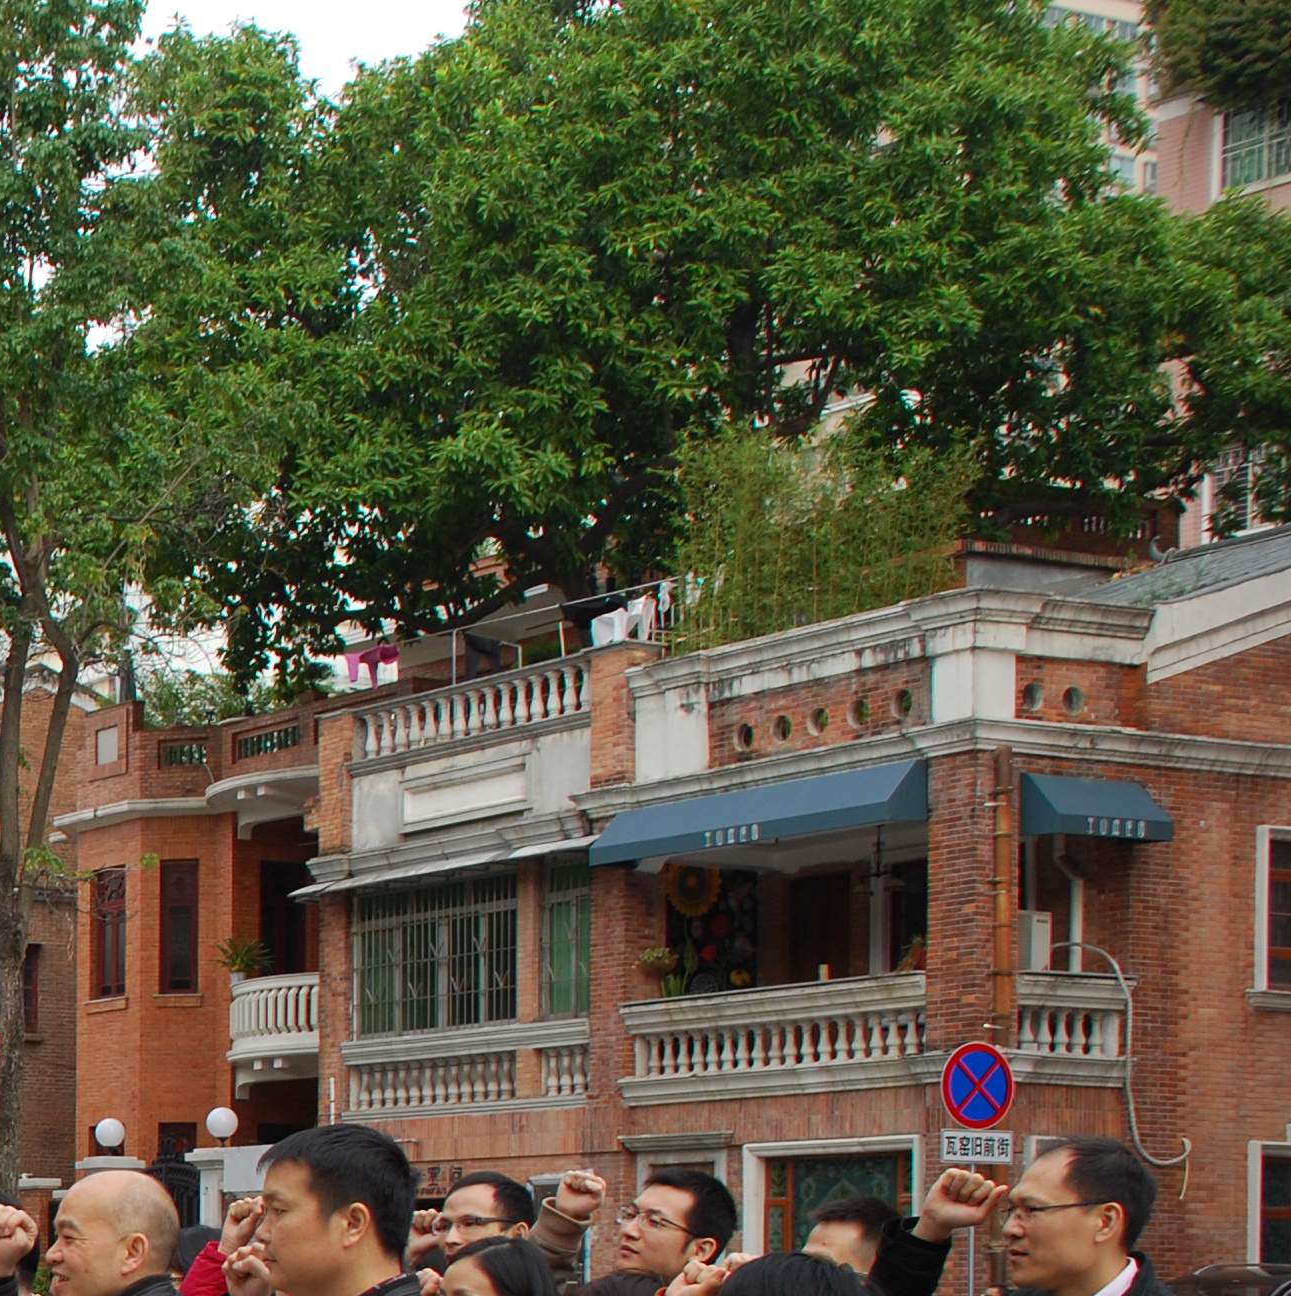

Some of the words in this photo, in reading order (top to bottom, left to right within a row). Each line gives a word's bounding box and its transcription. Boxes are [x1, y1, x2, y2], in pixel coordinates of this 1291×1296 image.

[945, 1136, 1010, 1158] 瓦窑旧前街
